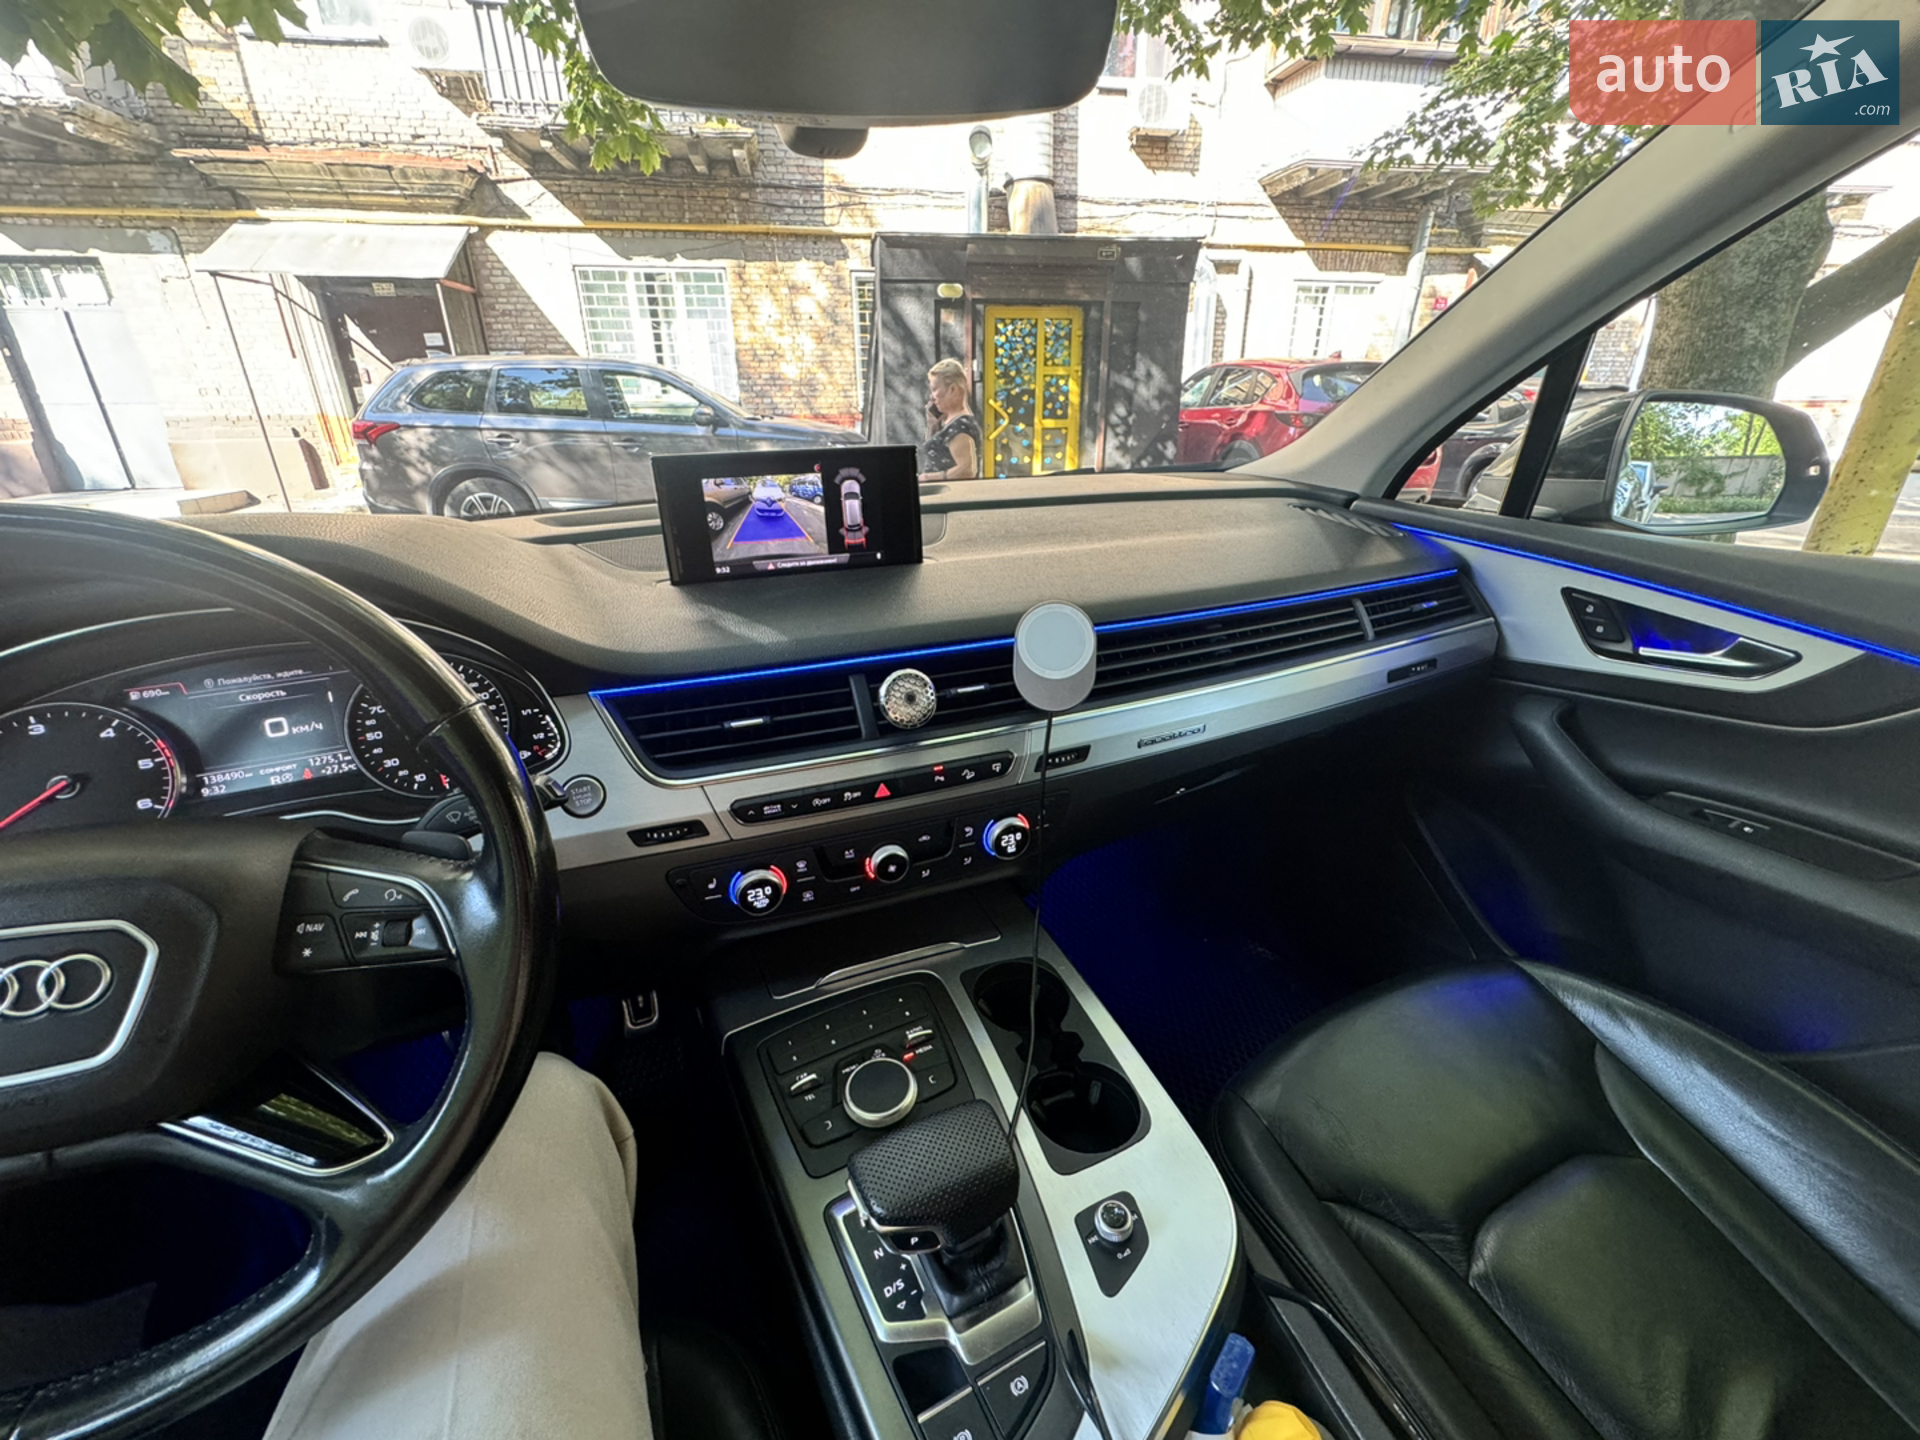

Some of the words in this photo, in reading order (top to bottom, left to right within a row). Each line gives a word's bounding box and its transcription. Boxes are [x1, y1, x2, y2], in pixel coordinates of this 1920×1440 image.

[238, 690, 287, 701] Скорость
[28, 723, 46, 735] 3
[99, 727, 116, 738] 4
[264, 716, 290, 738] 0
[291, 721, 324, 735] км/ч
[365, 731, 384, 741] 50
[137, 758, 154, 769] 5
[382, 757, 400, 768] 30
[259, 763, 298, 775] COMFORT
[270, 775, 281, 785] R
[414, 773, 427, 782] 10
[201, 785, 227, 797] 9:32
[136, 798, 153, 809] 6
[305, 922, 325, 932] NAV
[910, 1236, 919, 1245] P
[873, 1247, 885, 1260] N
[883, 1278, 905, 1298] D/S
